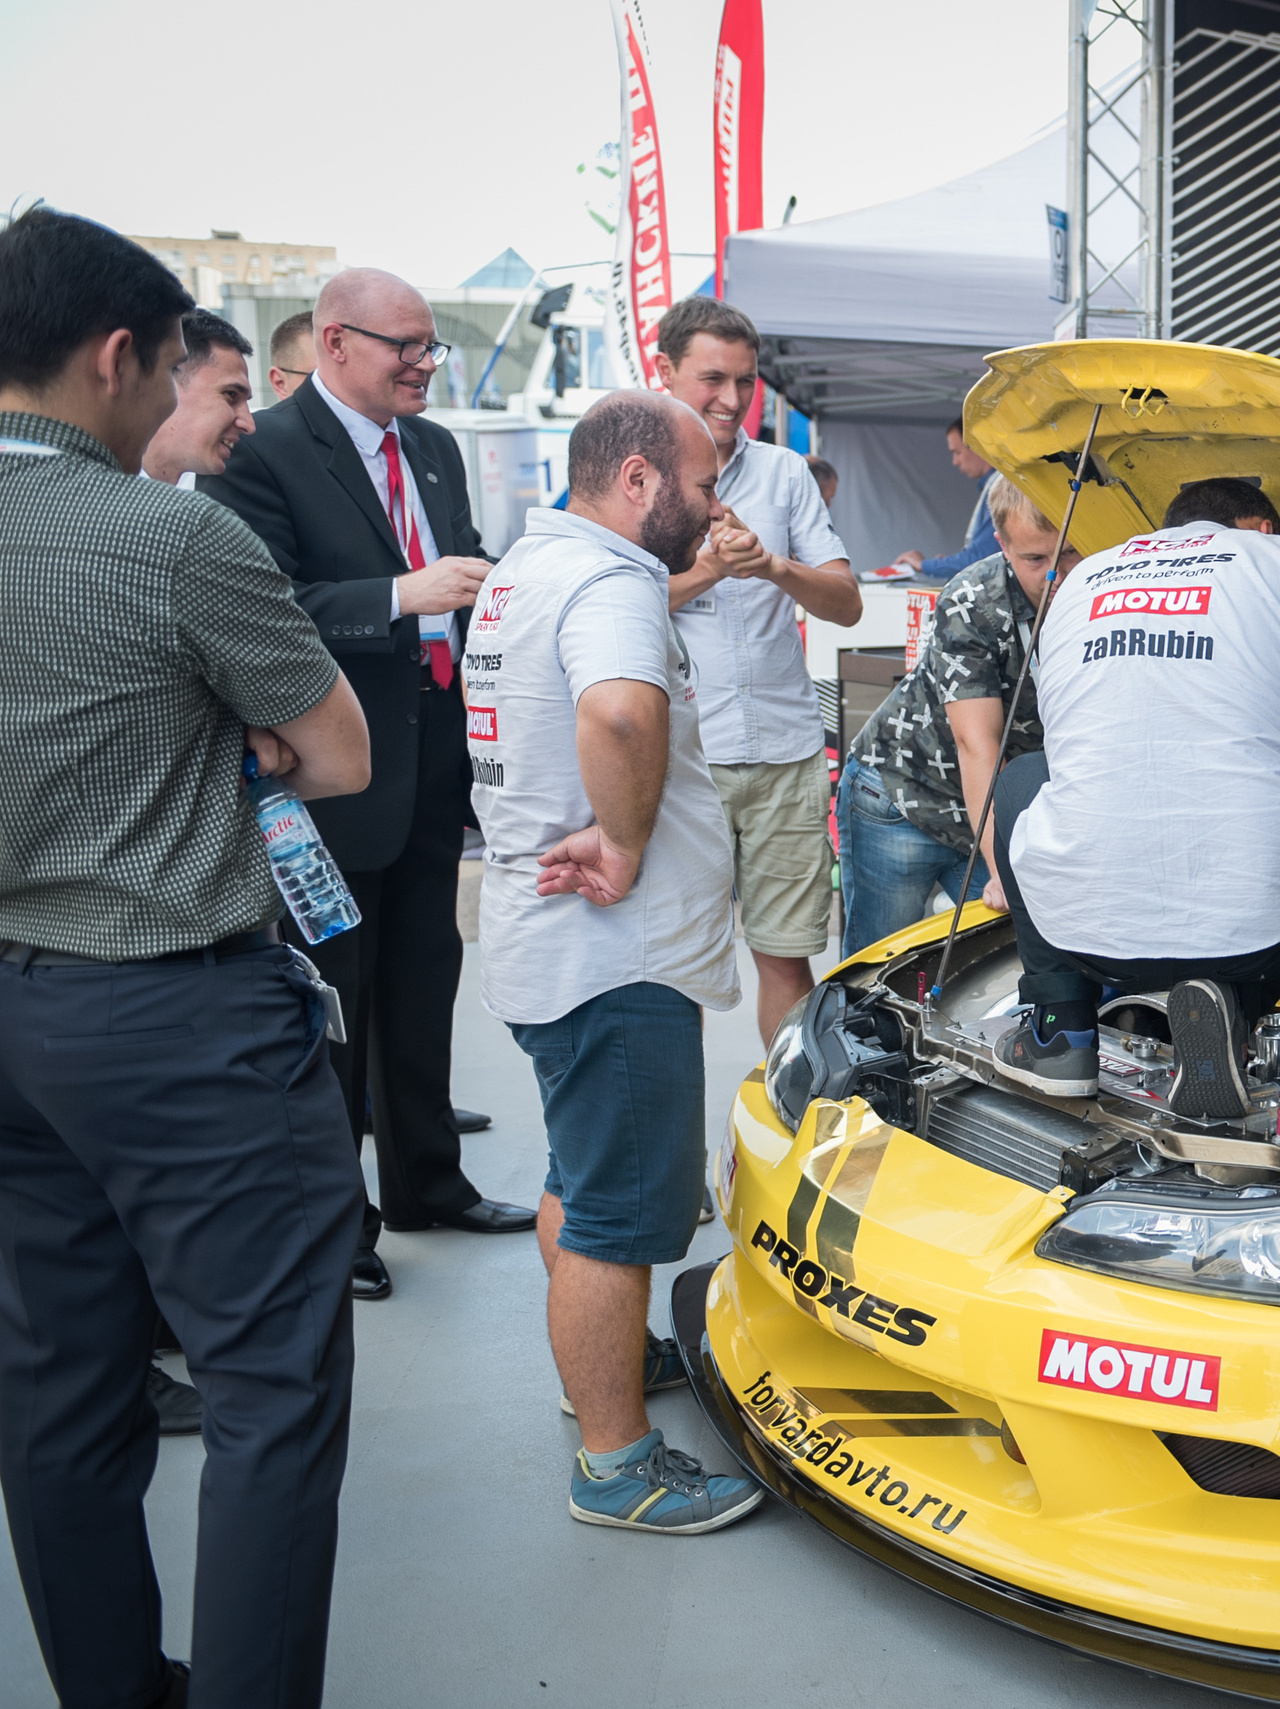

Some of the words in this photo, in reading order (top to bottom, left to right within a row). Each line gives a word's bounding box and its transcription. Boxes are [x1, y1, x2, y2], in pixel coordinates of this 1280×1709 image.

[1085, 560, 1151, 585] TOYO
[1156, 553, 1236, 568] TIRES
[1135, 571, 1152, 579] to
[1096, 590, 1203, 615] MOTUL
[1082, 628, 1214, 664] zaRRubin
[751, 1220, 937, 1347] PROXES
[1043, 1338, 1213, 1403] MOTUL
[743, 1371, 967, 1535] forvardavto.ru
